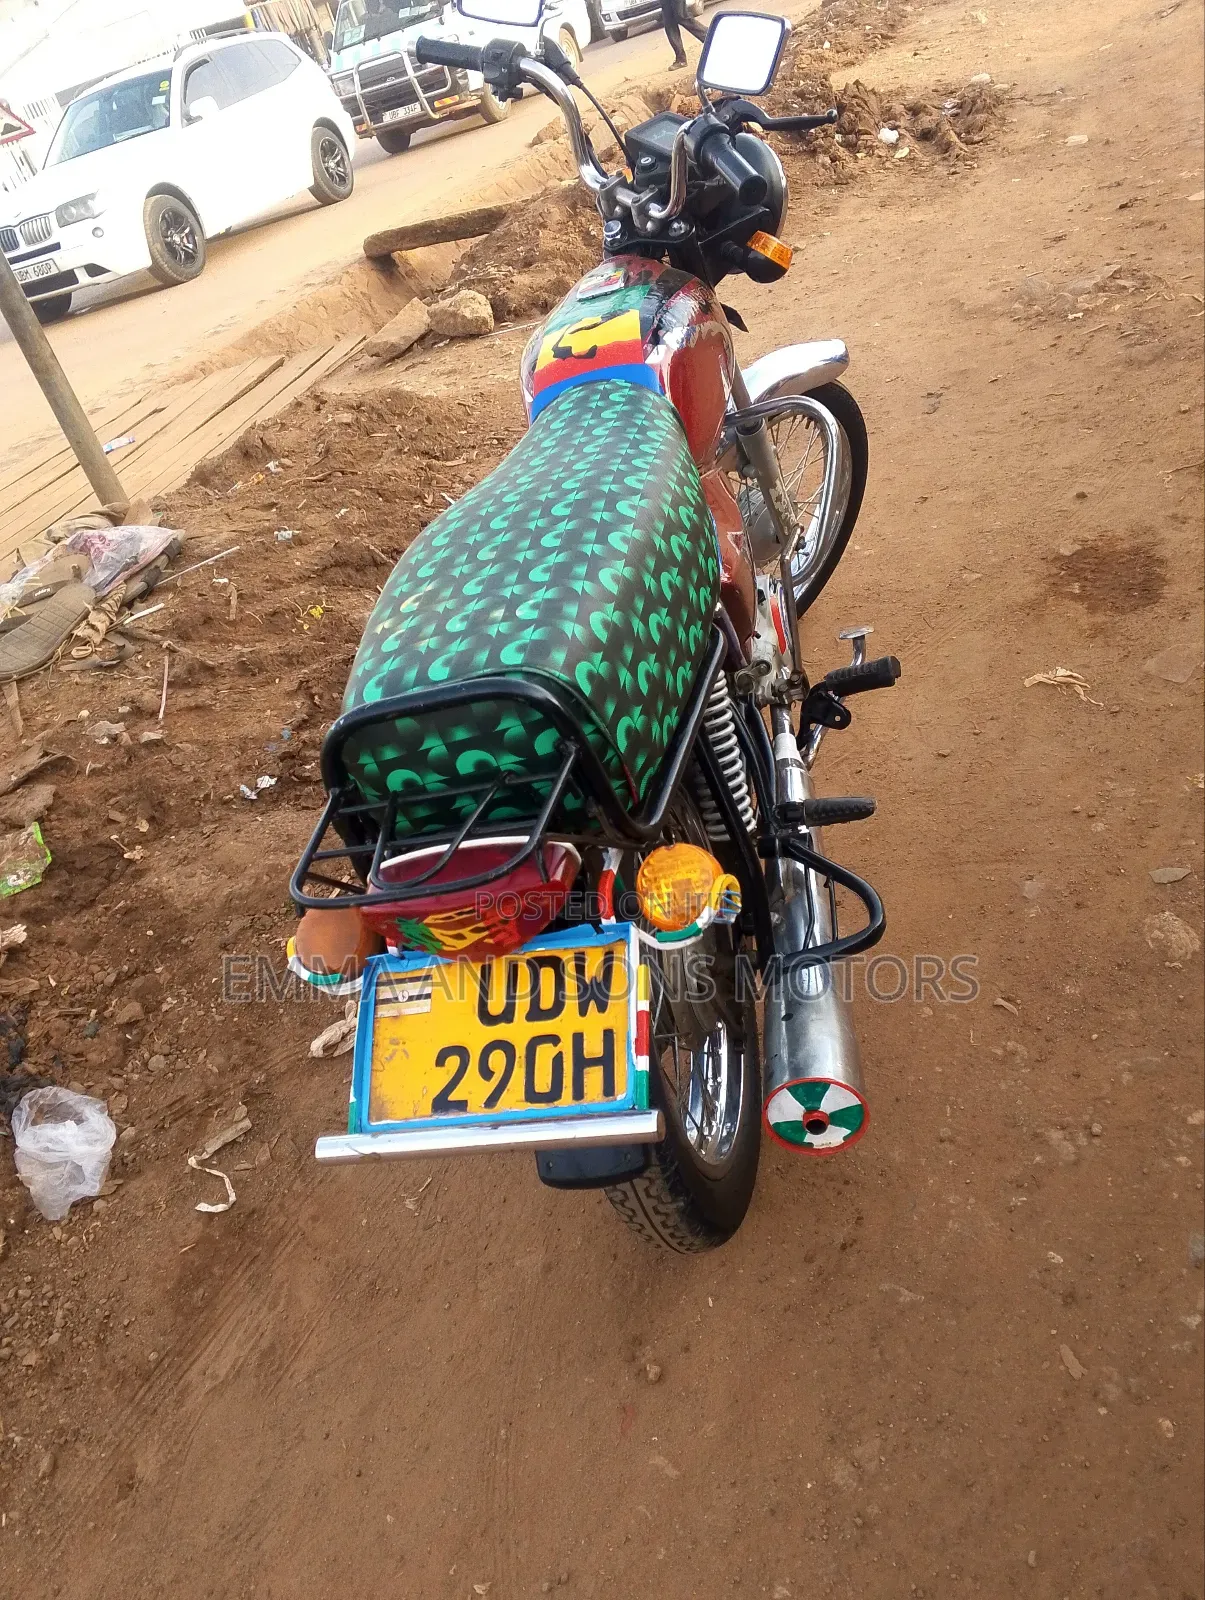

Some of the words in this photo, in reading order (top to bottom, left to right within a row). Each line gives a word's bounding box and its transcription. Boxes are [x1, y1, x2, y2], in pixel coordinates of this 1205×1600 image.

[33, 263, 53, 277] 680P
[478, 950, 615, 1027] UDW
[430, 1028, 617, 1114] 290H
